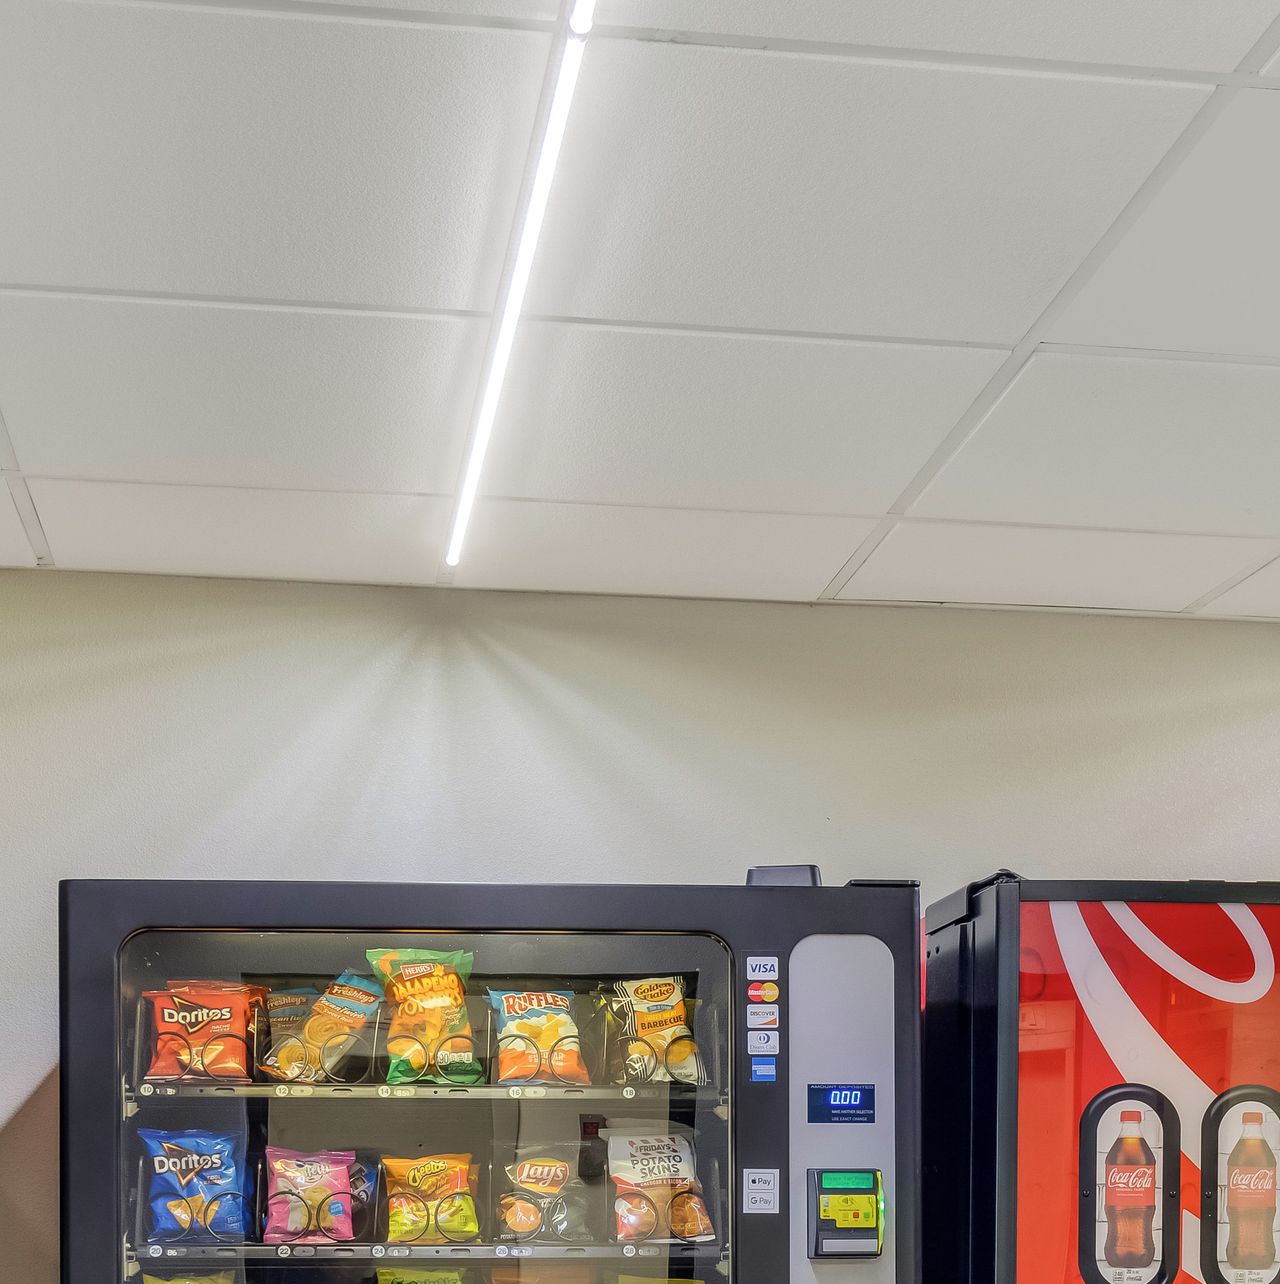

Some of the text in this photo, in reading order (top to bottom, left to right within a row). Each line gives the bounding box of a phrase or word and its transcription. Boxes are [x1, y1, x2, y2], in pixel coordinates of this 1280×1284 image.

[405, 965, 432, 975] HERR'S
[750, 963, 776, 973] VISA
[332, 985, 376, 1003] Freshley's
[635, 982, 673, 995] Golden
[643, 987, 672, 1000] Flake
[504, 992, 570, 1016] RUFFLES
[163, 1007, 232, 1024] Doritos
[640, 1014, 685, 1030] BARBECUE
[639, 1143, 671, 1153] FRIDAYS
[154, 1153, 222, 1175] Doritos
[630, 1154, 683, 1169] POTATO
[407, 1160, 448, 1187] Cheetos
[520, 1161, 567, 1184] Lay's
[640, 1163, 680, 1179] SKINS
[1107, 1167, 1153, 1188] Coca-Cola
[1229, 1168, 1273, 1190] Coca-Cola
[757, 1177, 772, 1187] Pay
[759, 1197, 772, 1206] Pay
